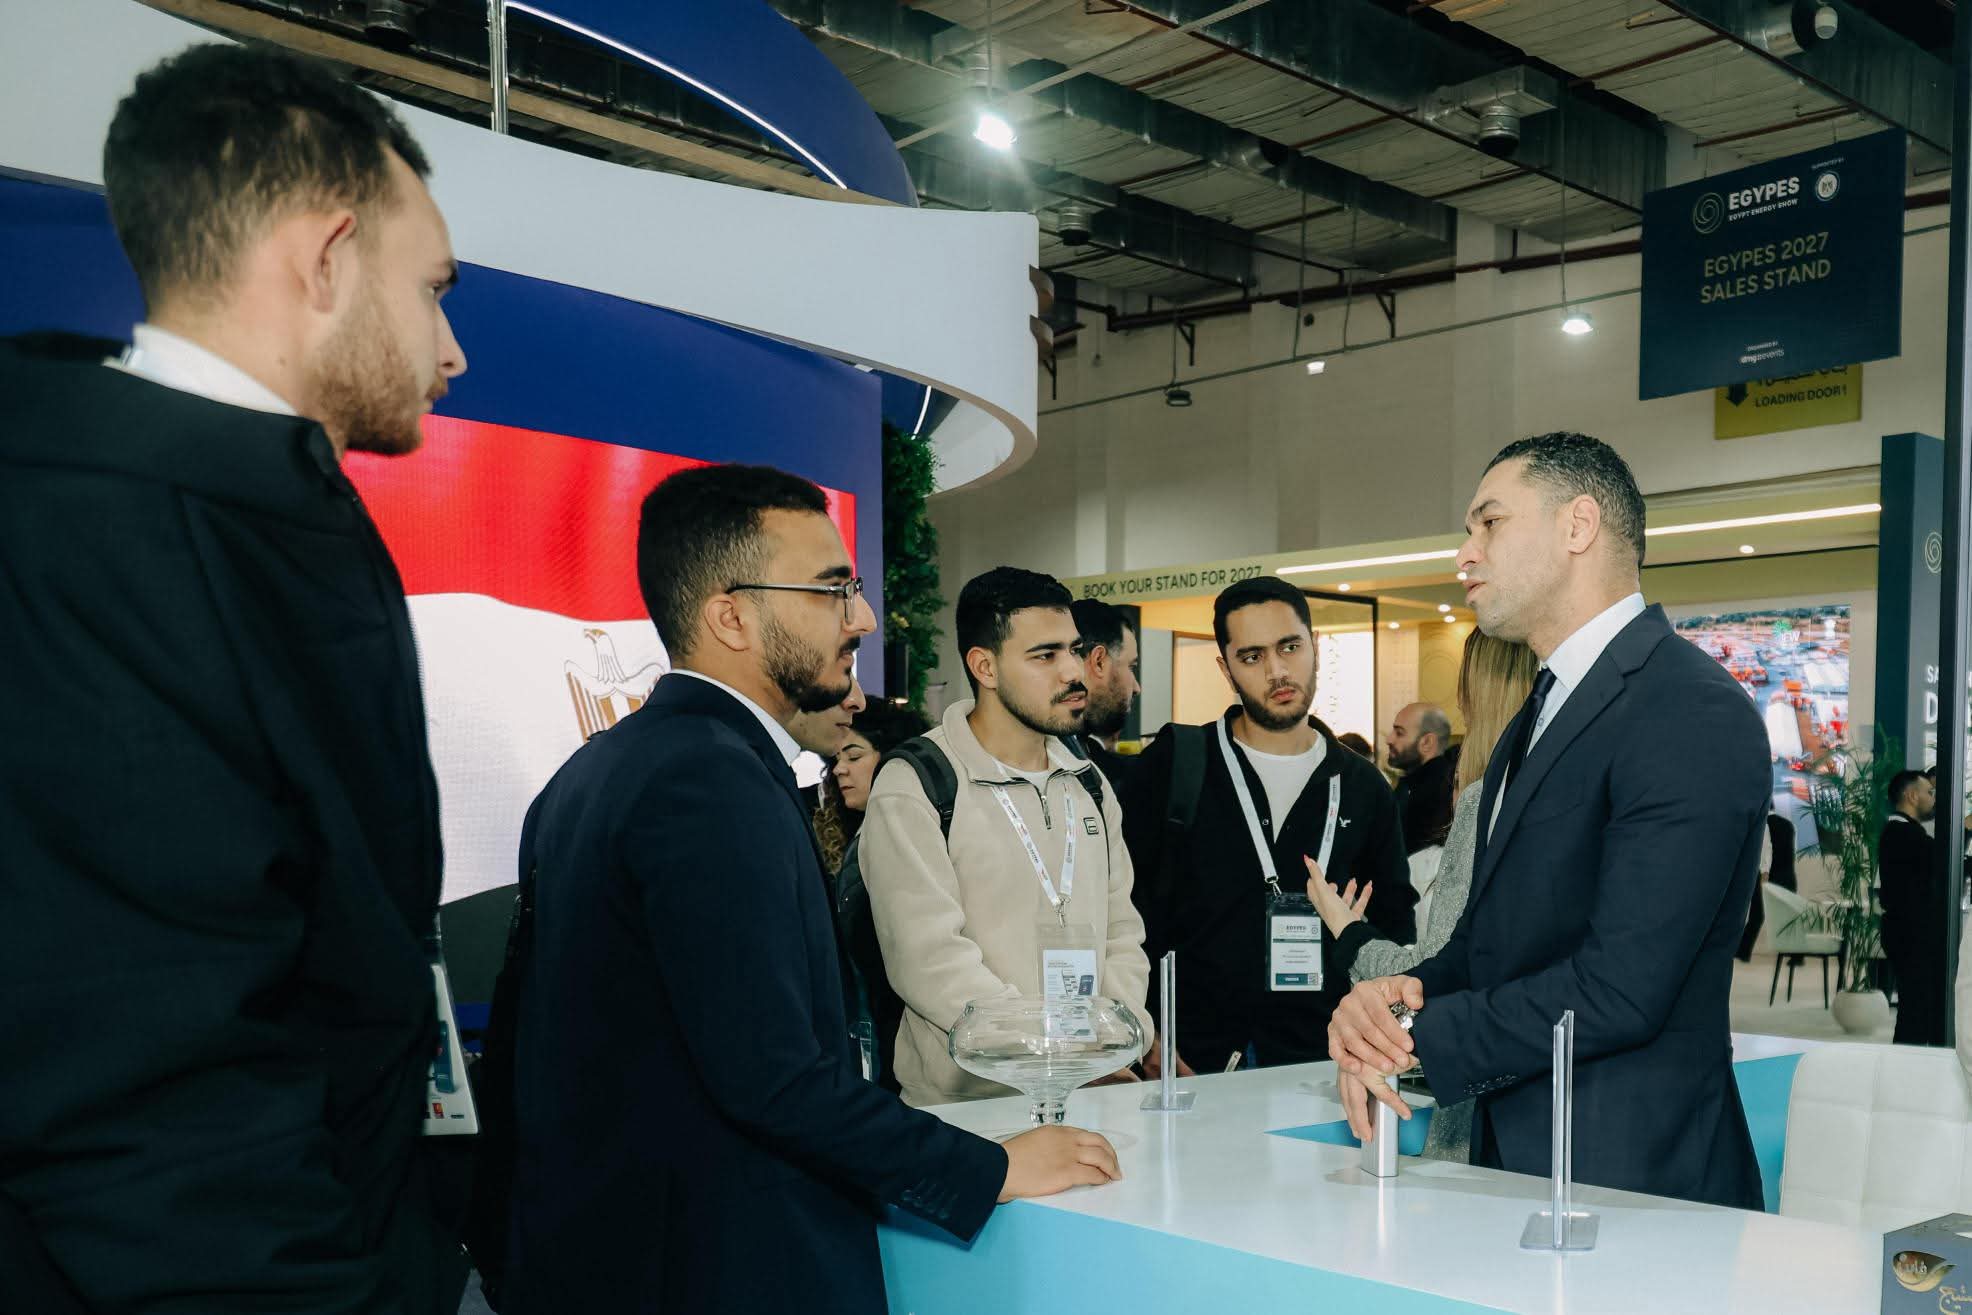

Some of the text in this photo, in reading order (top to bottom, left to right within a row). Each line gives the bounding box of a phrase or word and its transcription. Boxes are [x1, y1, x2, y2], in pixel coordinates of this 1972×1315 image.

[1729, 177, 1799, 210] EGYPES
[1729, 198, 1798, 221] EGYPT ENERGY SHOW
[1704, 231, 1829, 277] EGYPES 2027
[1701, 259, 1831, 303] SALES STAND
[1755, 391, 1805, 407] LOADING
[1083, 565, 1262, 599] BOOK YOUR STAND FOR 2027
